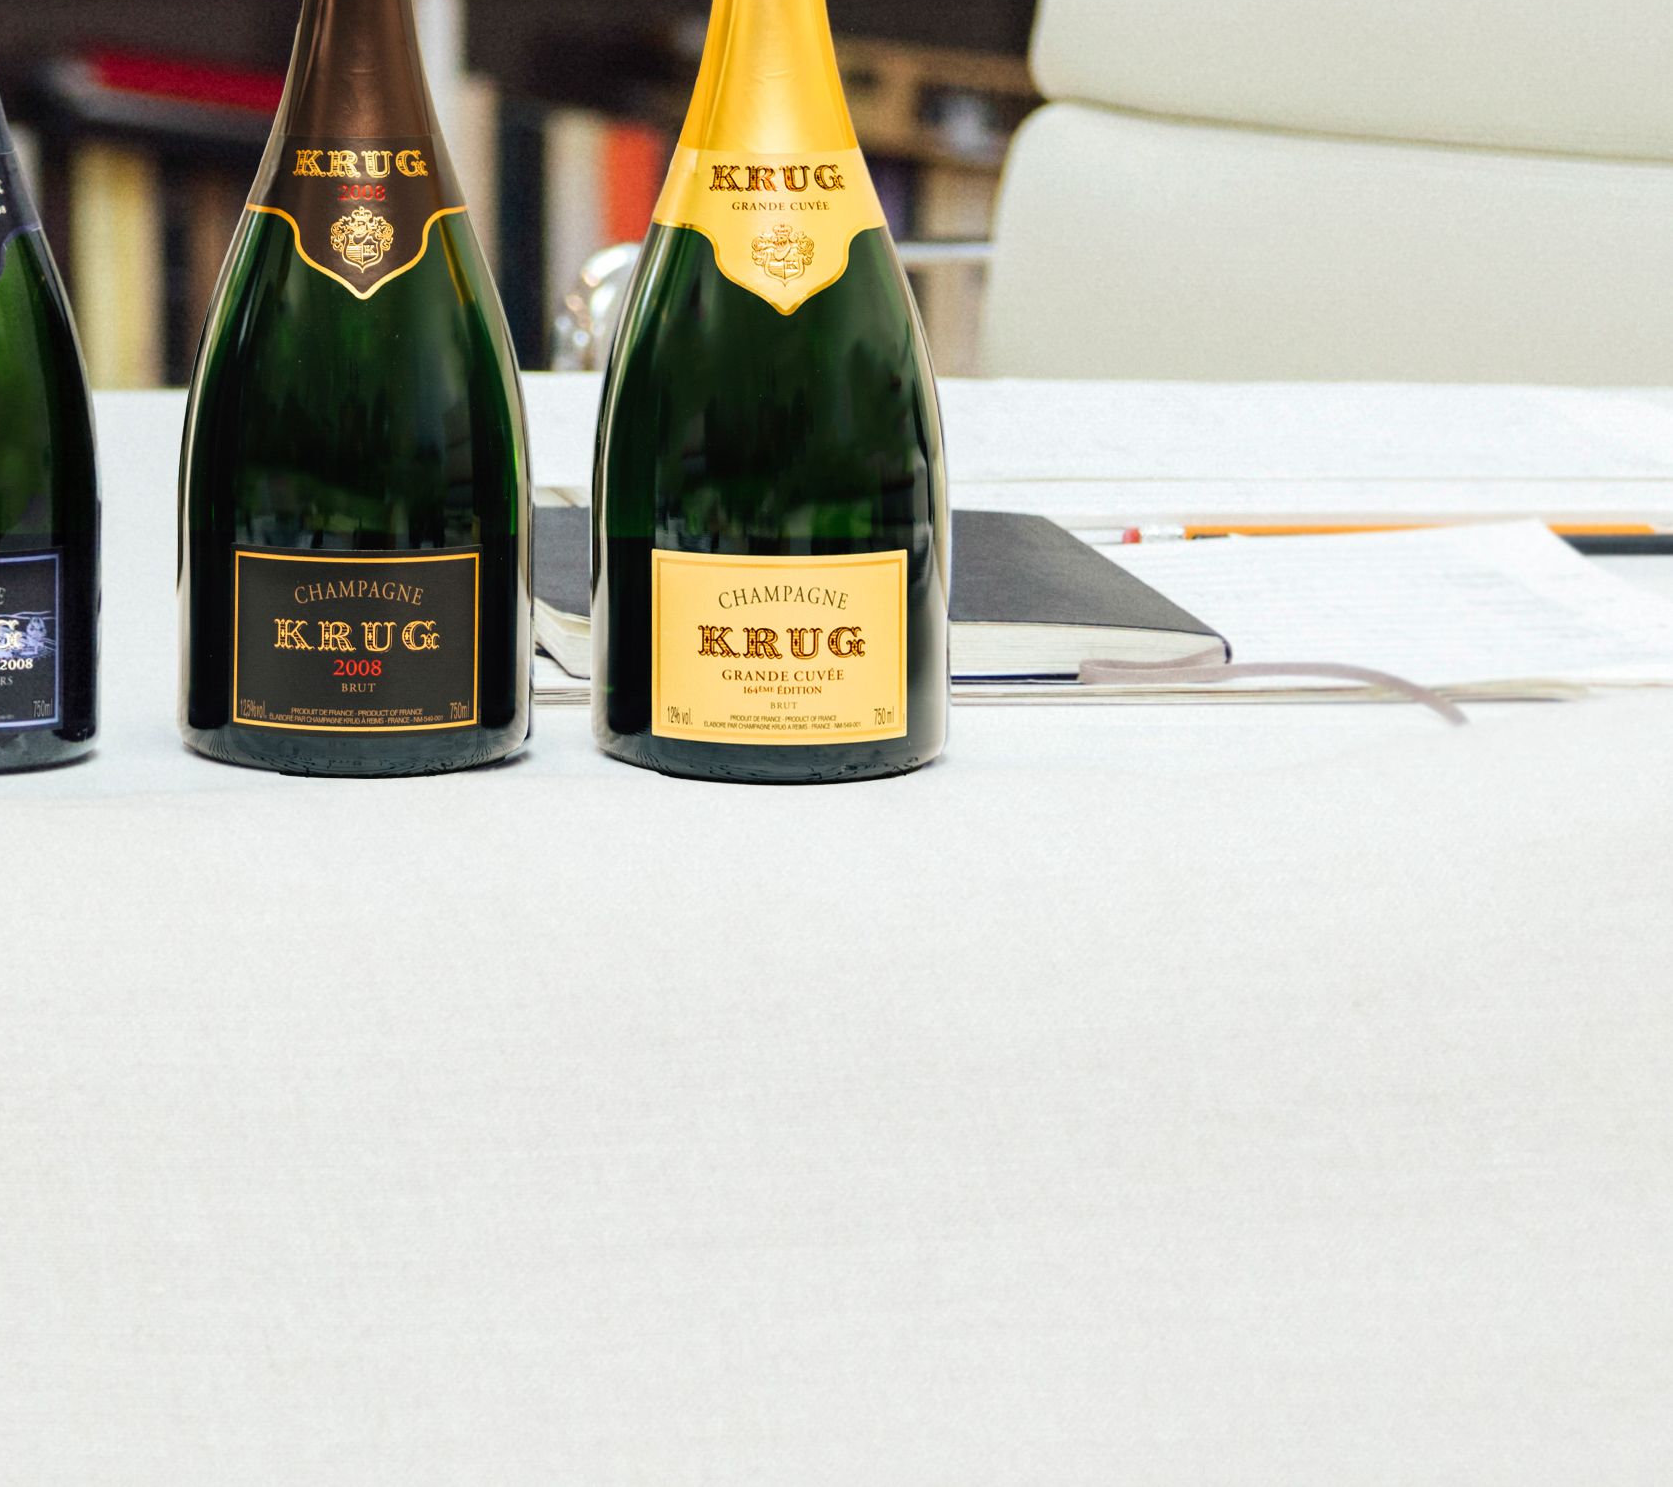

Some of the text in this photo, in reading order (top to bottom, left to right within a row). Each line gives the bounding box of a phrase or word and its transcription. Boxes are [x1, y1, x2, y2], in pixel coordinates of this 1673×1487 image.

[293, 149, 428, 178] KRUG
[709, 164, 845, 192] KRUG
[337, 184, 386, 201] 2008
[731, 200, 830, 211] GRANDE CUVÉE
[294, 579, 424, 606] CHAMPAGNE
[718, 585, 849, 610] CHAMPAGNE
[273, 618, 441, 652] KRUG
[697, 624, 866, 660] KRUG
[0, 657, 34, 671] 2008
[333, 659, 383, 677] 2008
[722, 668, 844, 682] GRANDE CUVÉE
[341, 682, 377, 693] BRUT
[777, 684, 822, 695] ÉDITION
[291, 707, 318, 715] PRODUIT
[319, 708, 328, 716] DE
[328, 708, 354, 716] FRANCE
[358, 709, 389, 717] PRODUCT
[398, 708, 423, 716] FRANCE
[770, 701, 798, 709] BRUT
[306, 716, 343, 724] CHAMPAGNE
[388, 716, 410, 724] FRANCE
[667, 706, 680, 724] 12%
[730, 714, 752, 722] PRODUIT
[760, 715, 781, 723] FRANCE
[817, 714, 837, 722] FRANCE
